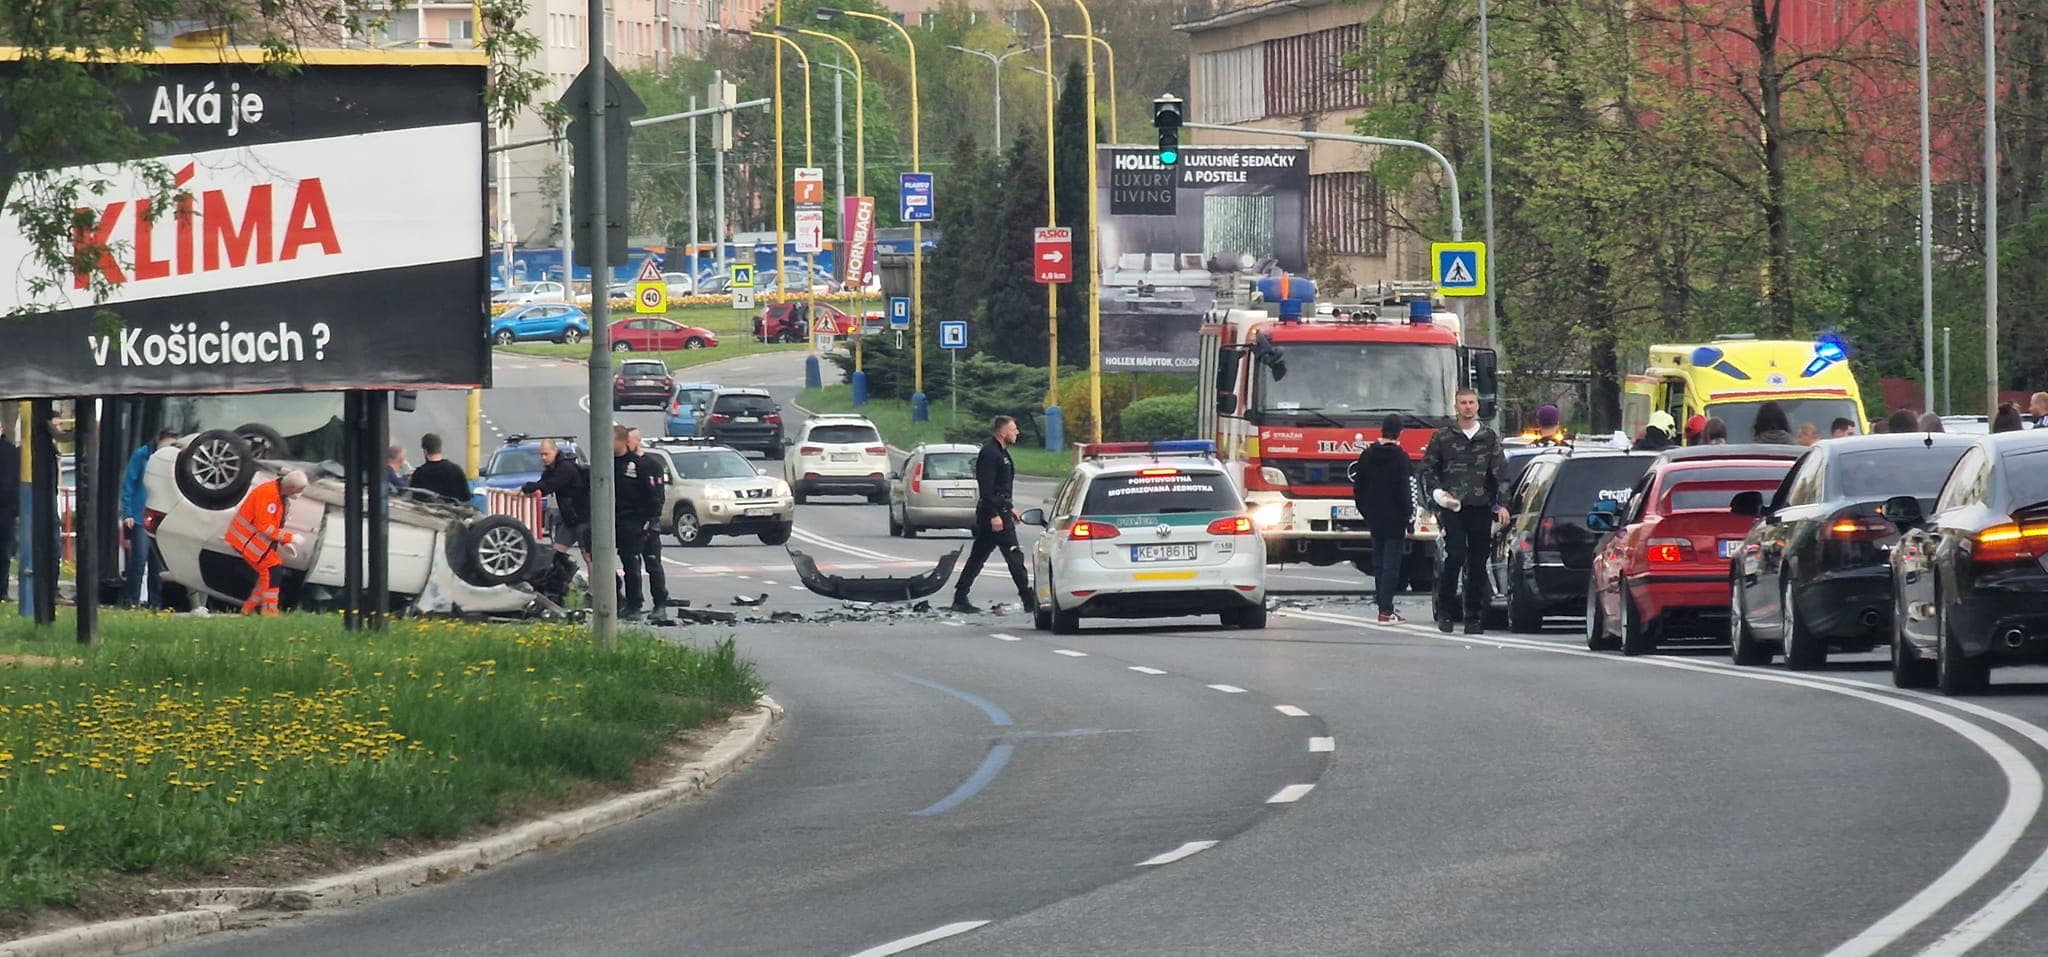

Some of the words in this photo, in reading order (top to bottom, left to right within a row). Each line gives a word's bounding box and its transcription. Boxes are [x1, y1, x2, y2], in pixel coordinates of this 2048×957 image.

[149, 81, 221, 125] Aká
[227, 82, 264, 136] je
[1115, 154, 1173, 170] HOLLE
[1184, 153, 1239, 167] LUXUSNÉ
[1241, 153, 1296, 168] SEDAČKY
[1115, 174, 1172, 187] LUXURY
[1184, 171, 1194, 182] A
[1196, 171, 1247, 183] POSTELE
[1115, 190, 1172, 203] LIVING
[73, 161, 342, 290] KLÍMA
[847, 202, 873, 281] HORNBACH
[1039, 230, 1069, 239] ASKO
[645, 292, 658, 302] 40
[88, 335, 109, 366] v
[120, 321, 304, 367] Košiciach
[312, 323, 331, 361] ?
[1318, 440, 1375, 454] HAS
